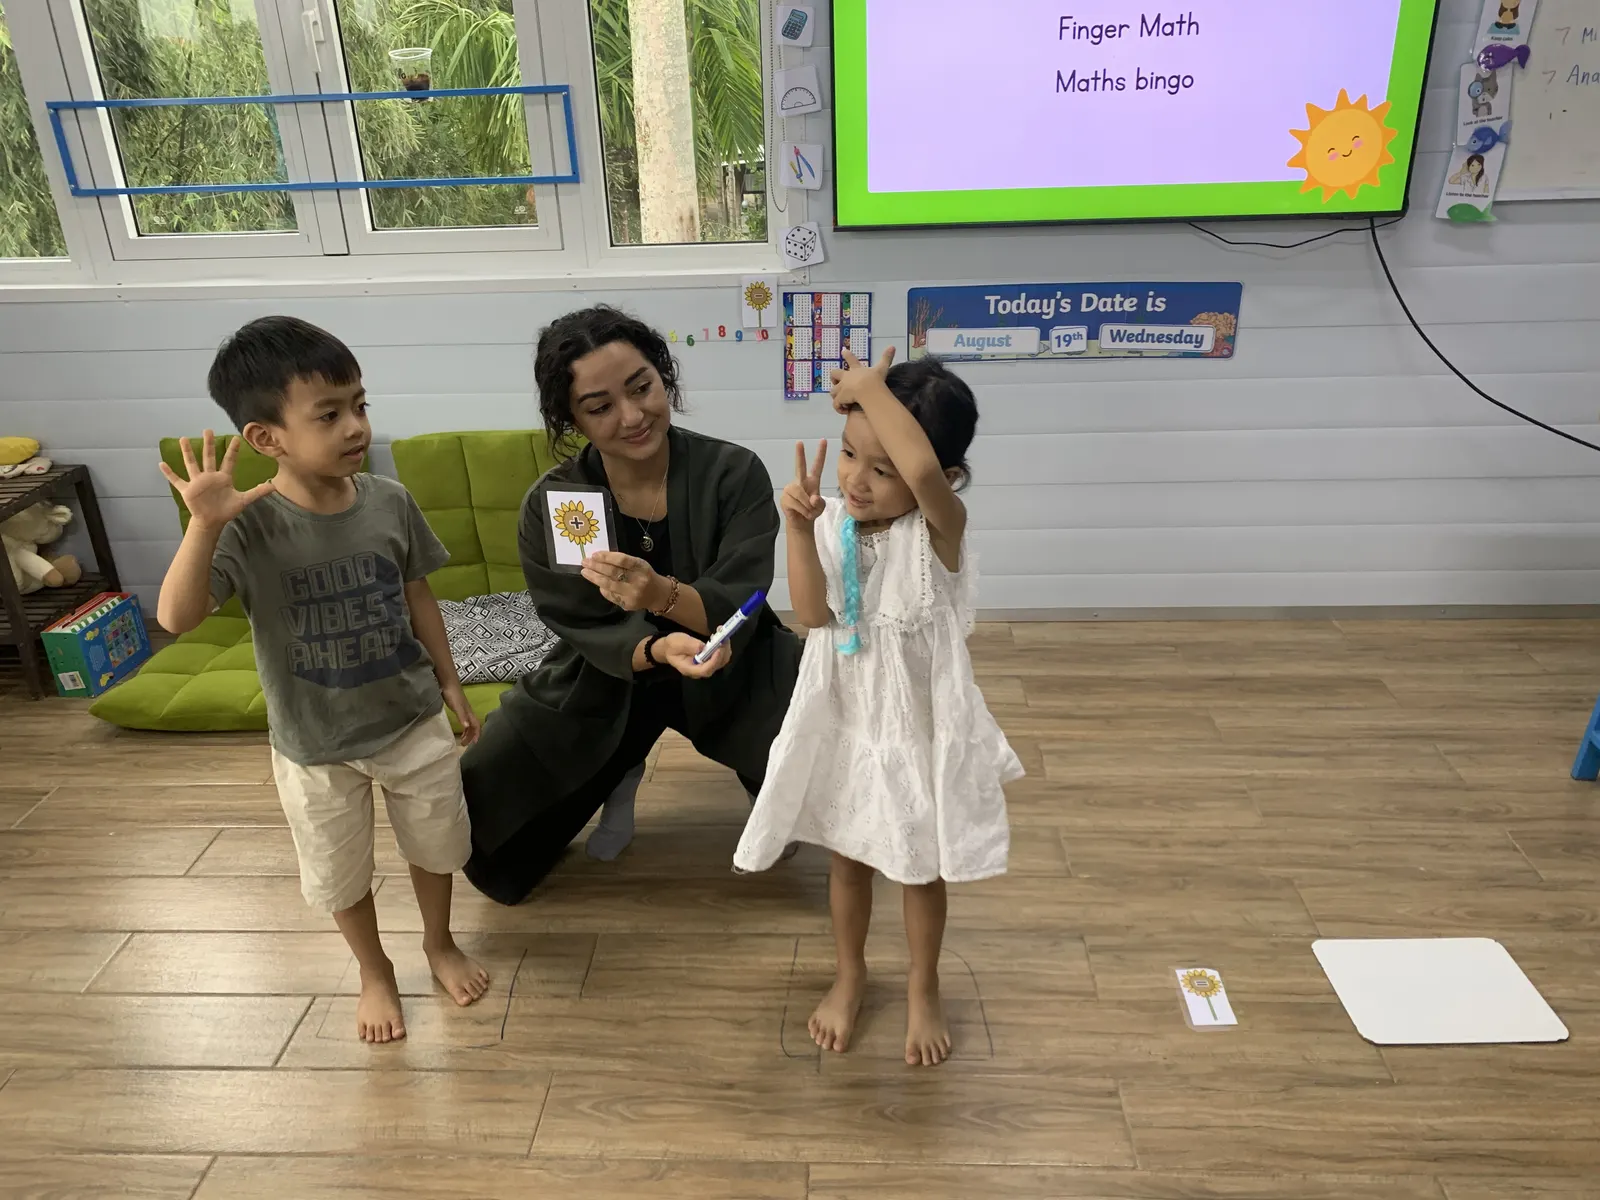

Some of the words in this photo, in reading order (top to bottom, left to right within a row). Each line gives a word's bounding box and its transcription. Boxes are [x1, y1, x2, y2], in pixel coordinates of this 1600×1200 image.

[1059, 16, 1130, 45] Finger
[1140, 12, 1200, 38] Math
[1056, 68, 1126, 93] Maths
[1136, 67, 1194, 95] bingo
[985, 292, 1071, 319] Today's
[1081, 293, 1137, 312] Date
[1146, 291, 1167, 312] is
[668, 329, 677, 343] 5
[686, 334, 695, 347] 6
[718, 325, 726, 338] 8
[735, 329, 743, 342] 9
[843, 328, 850, 337] 6
[953, 334, 1012, 351] August
[1054, 333, 1083, 349] 19th
[1110, 329, 1204, 349] Wednesday
[787, 361, 793, 370] 7
[281, 551, 377, 600] GOOD
[279, 591, 388, 637] VIBES
[286, 624, 402, 673] AHEAD
